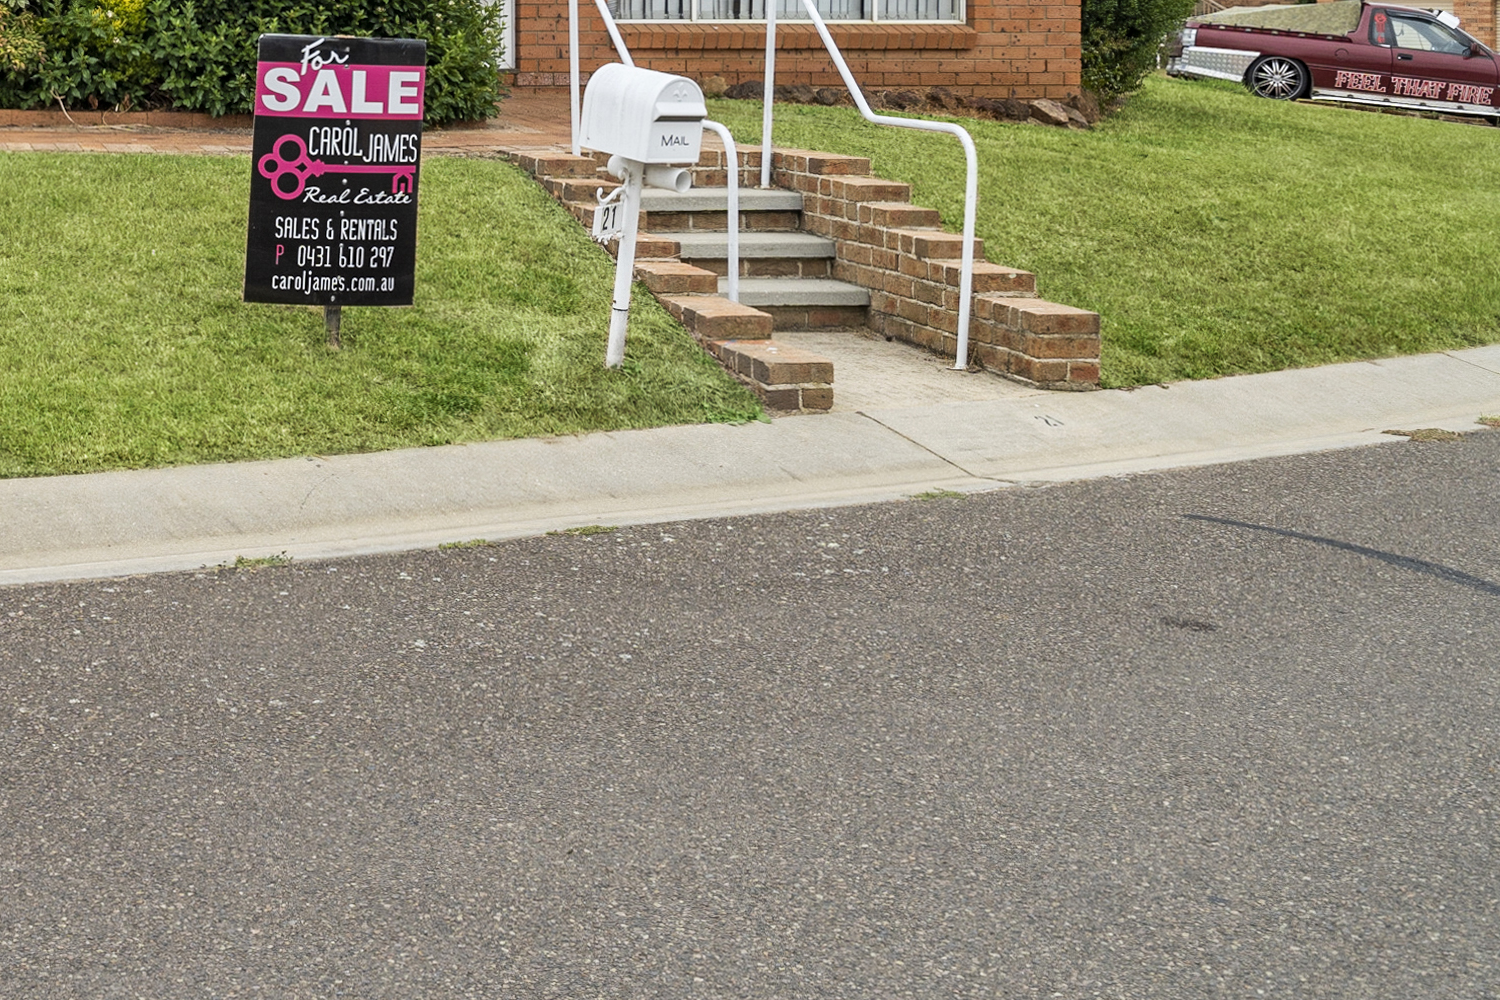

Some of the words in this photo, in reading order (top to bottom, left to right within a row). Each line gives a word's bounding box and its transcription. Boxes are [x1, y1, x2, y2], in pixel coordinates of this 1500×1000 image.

[301, 38, 349, 76] For
[261, 67, 421, 115] SALE
[1334, 70, 1386, 92] FEEL
[1391, 76, 1446, 98] THAT
[1446, 82, 1494, 104] FIRE
[308, 126, 363, 157] CAROL
[362, 133, 418, 163] JAMES
[302, 186, 350, 205] Real
[353, 187, 413, 205] Estate
[274, 216, 320, 240] SALES
[326, 218, 334, 240] &
[340, 218, 398, 241] RENTALS
[602, 205, 617, 231] 21
[275, 244, 285, 265] P
[297, 245, 332, 268] 0431
[339, 245, 364, 268] 610
[369, 246, 395, 268] 297
[271, 270, 395, 295] caroljames.com.au
